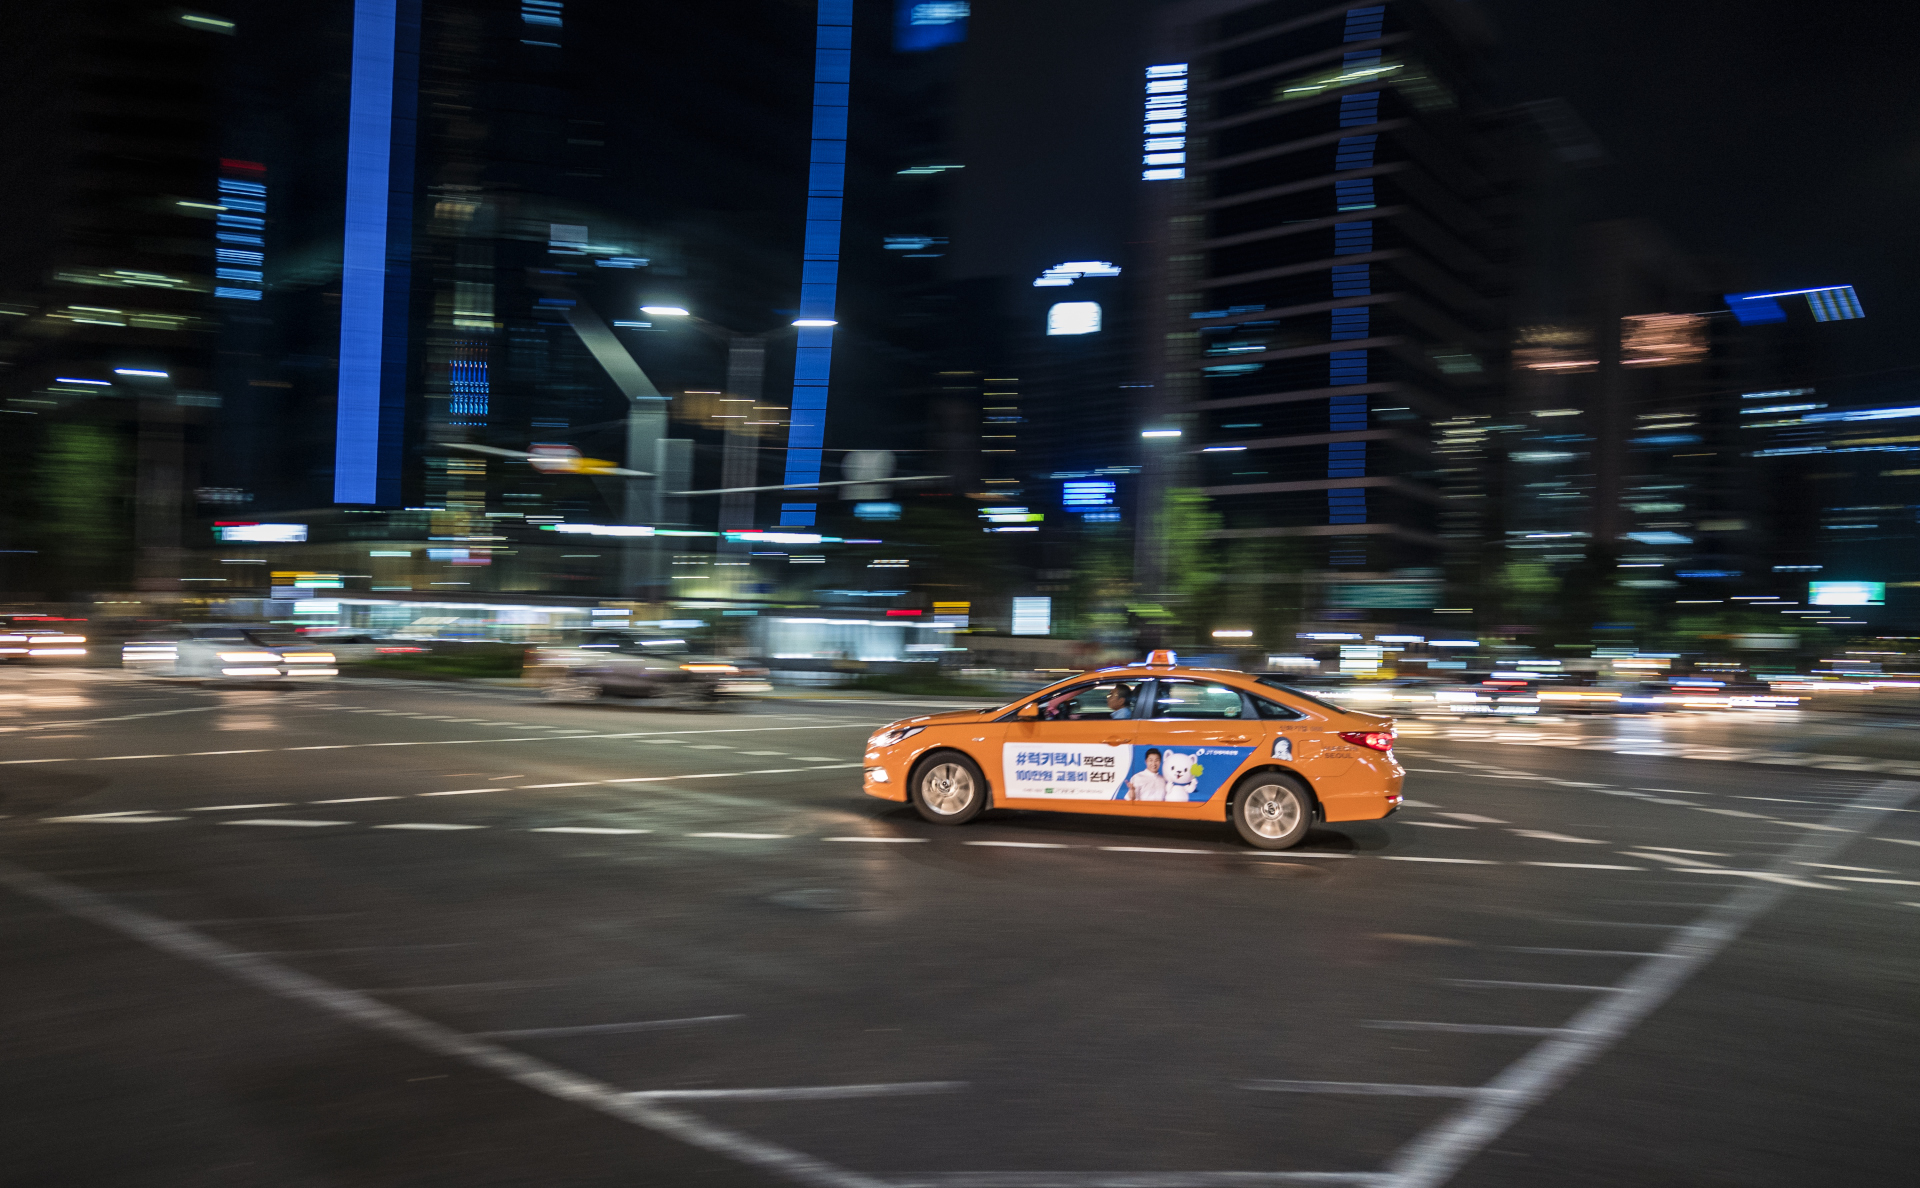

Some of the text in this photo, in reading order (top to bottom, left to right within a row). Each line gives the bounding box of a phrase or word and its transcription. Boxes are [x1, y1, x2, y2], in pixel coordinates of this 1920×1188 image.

[1015, 751, 1082, 767] #럭키택시
[1015, 769, 1116, 783] 100만원 교통비 쏜다!
